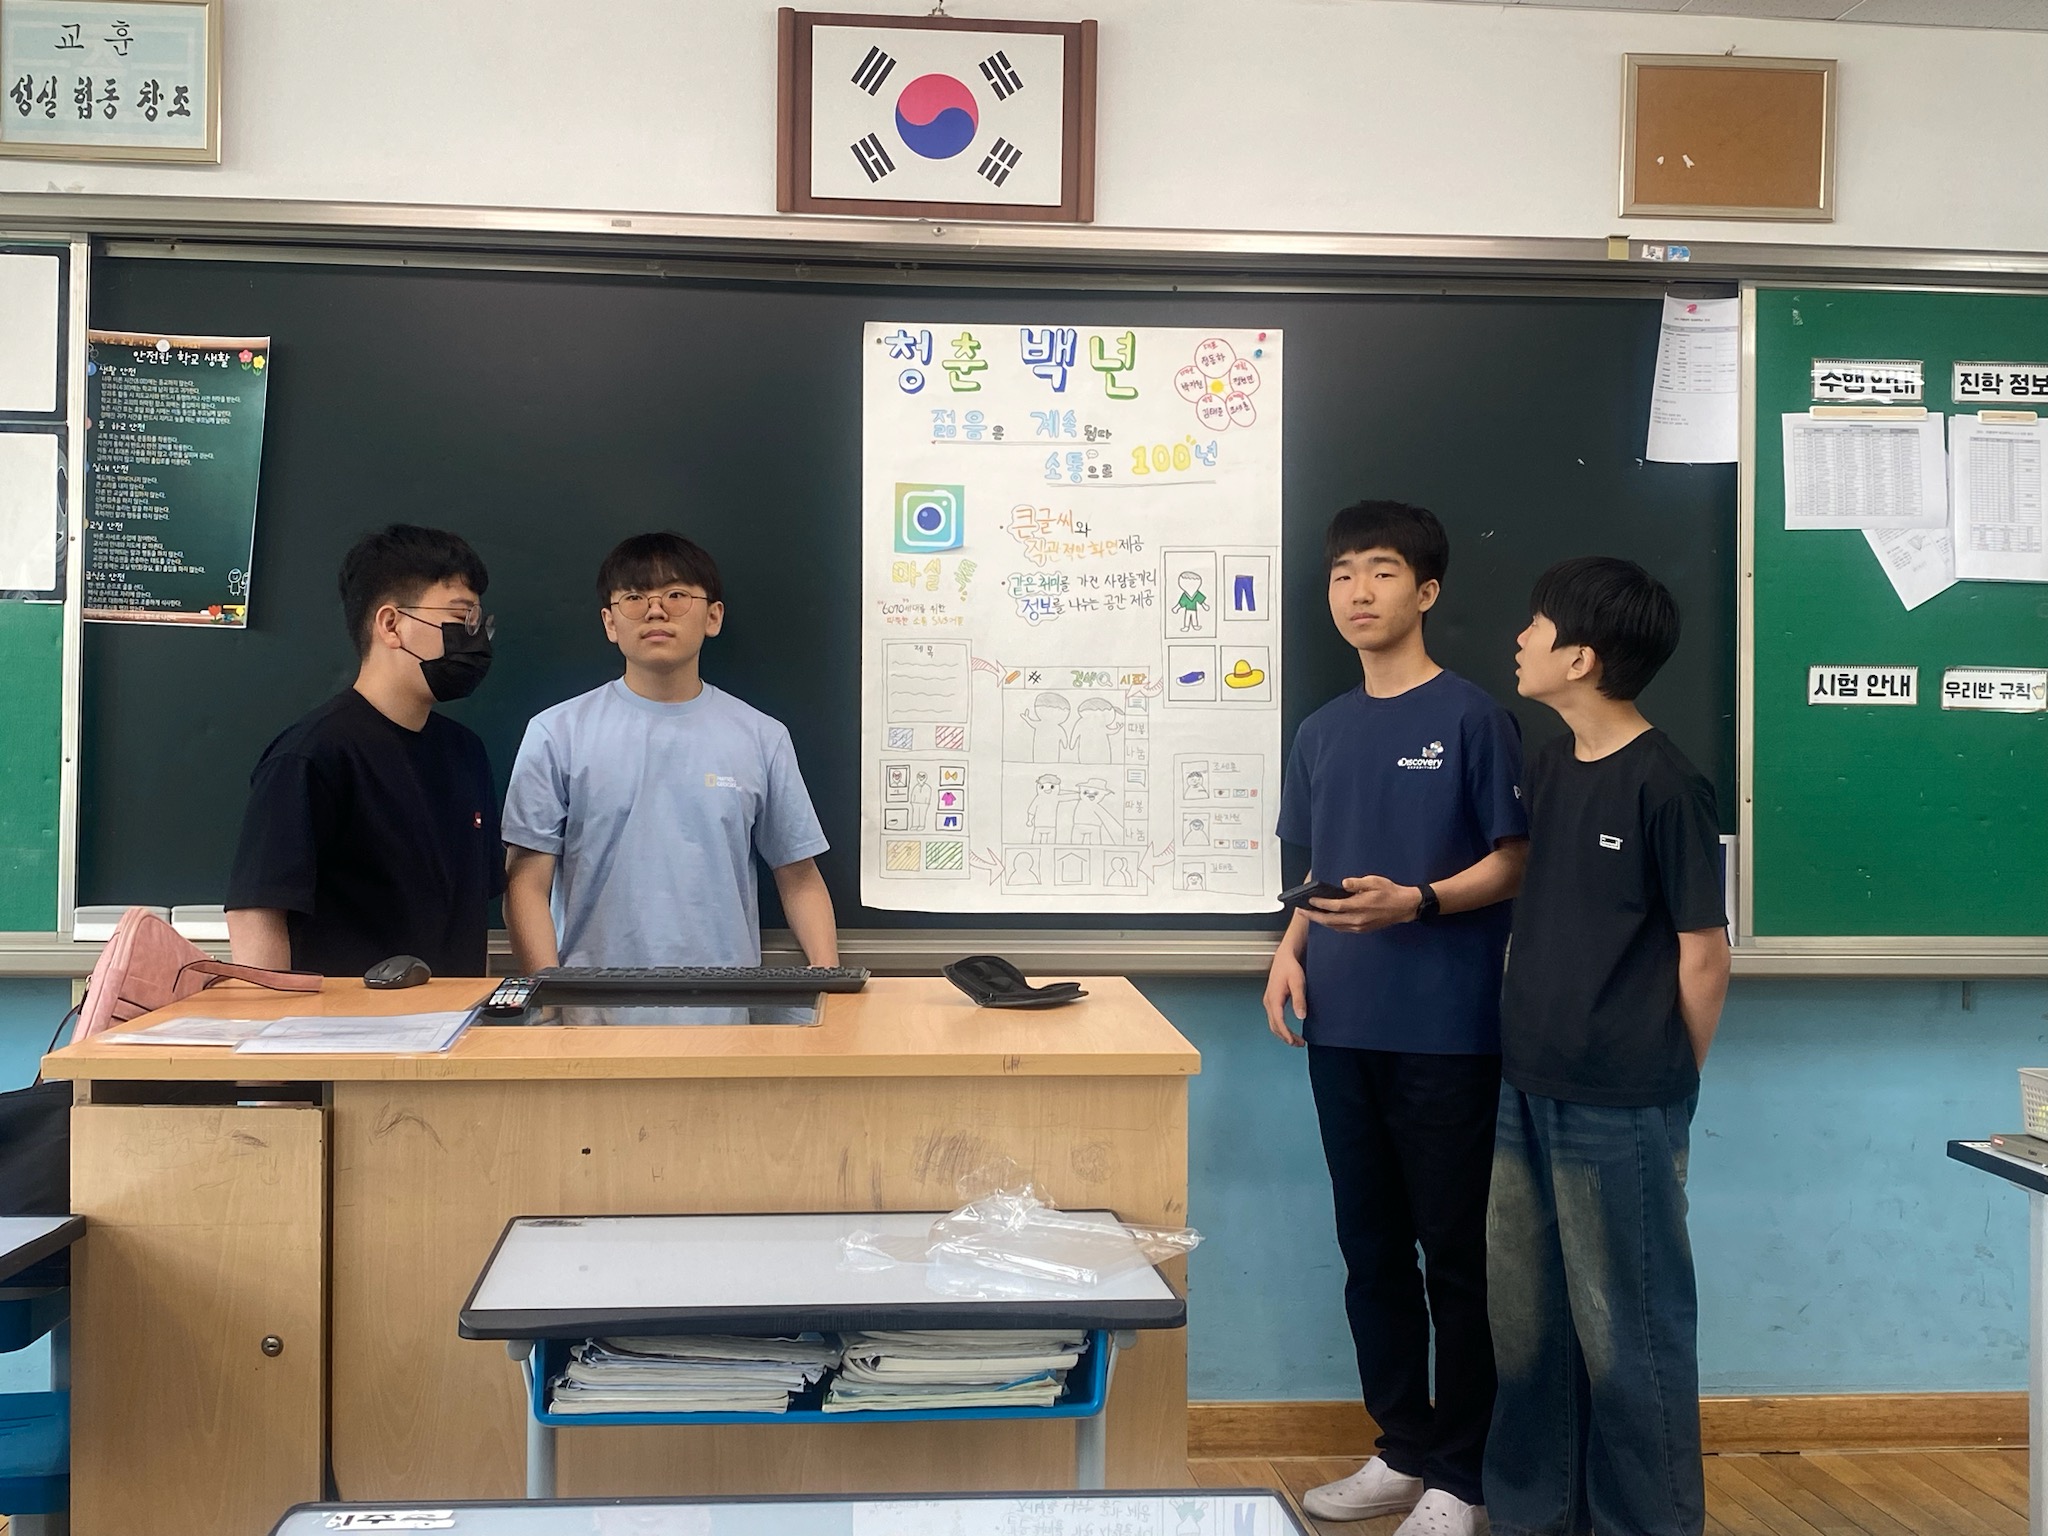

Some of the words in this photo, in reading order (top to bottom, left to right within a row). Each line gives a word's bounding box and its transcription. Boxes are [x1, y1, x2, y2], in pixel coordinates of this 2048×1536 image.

[10, 73, 58, 119] 성실
[74, 76, 120, 120] 협동
[137, 79, 191, 122] 창조
[133, 350, 173, 364] 안전한
[177, 350, 200, 367] 학교
[204, 351, 231, 368] 생활
[884, 329, 989, 395] 청춘
[1020, 327, 1139, 400] 백년
[119, 367, 137, 377] 안전
[1959, 372, 2004, 395] 진학
[129, 423, 146, 433] 안전
[1030, 409, 1078, 439] 계속
[93, 463, 110, 473] 실내
[113, 465, 129, 474] 안전
[1044, 451, 1113, 484] 소통으로
[90, 521, 104, 531] 교실
[107, 522, 124, 532] 안전
[109, 572, 126, 582] 안전
[892, 558, 942, 592] 마실
[1021, 597, 1066, 621] 정보를
[1068, 597, 1100, 612] 나누는
[1103, 593, 1127, 611] 공간
[1130, 589, 1155, 609] 제공
[1813, 673, 1858, 697] 시험
[1866, 673, 1911, 697] 안내
[1944, 680, 1995, 699] 우리반
[1999, 682, 2031, 700] 규칙
[1127, 723, 1146, 735] 따봉
[1126, 747, 1146, 761] 나눔
[1397, 757, 1443, 769] Discovery
[1125, 828, 1145, 842] 나눔
